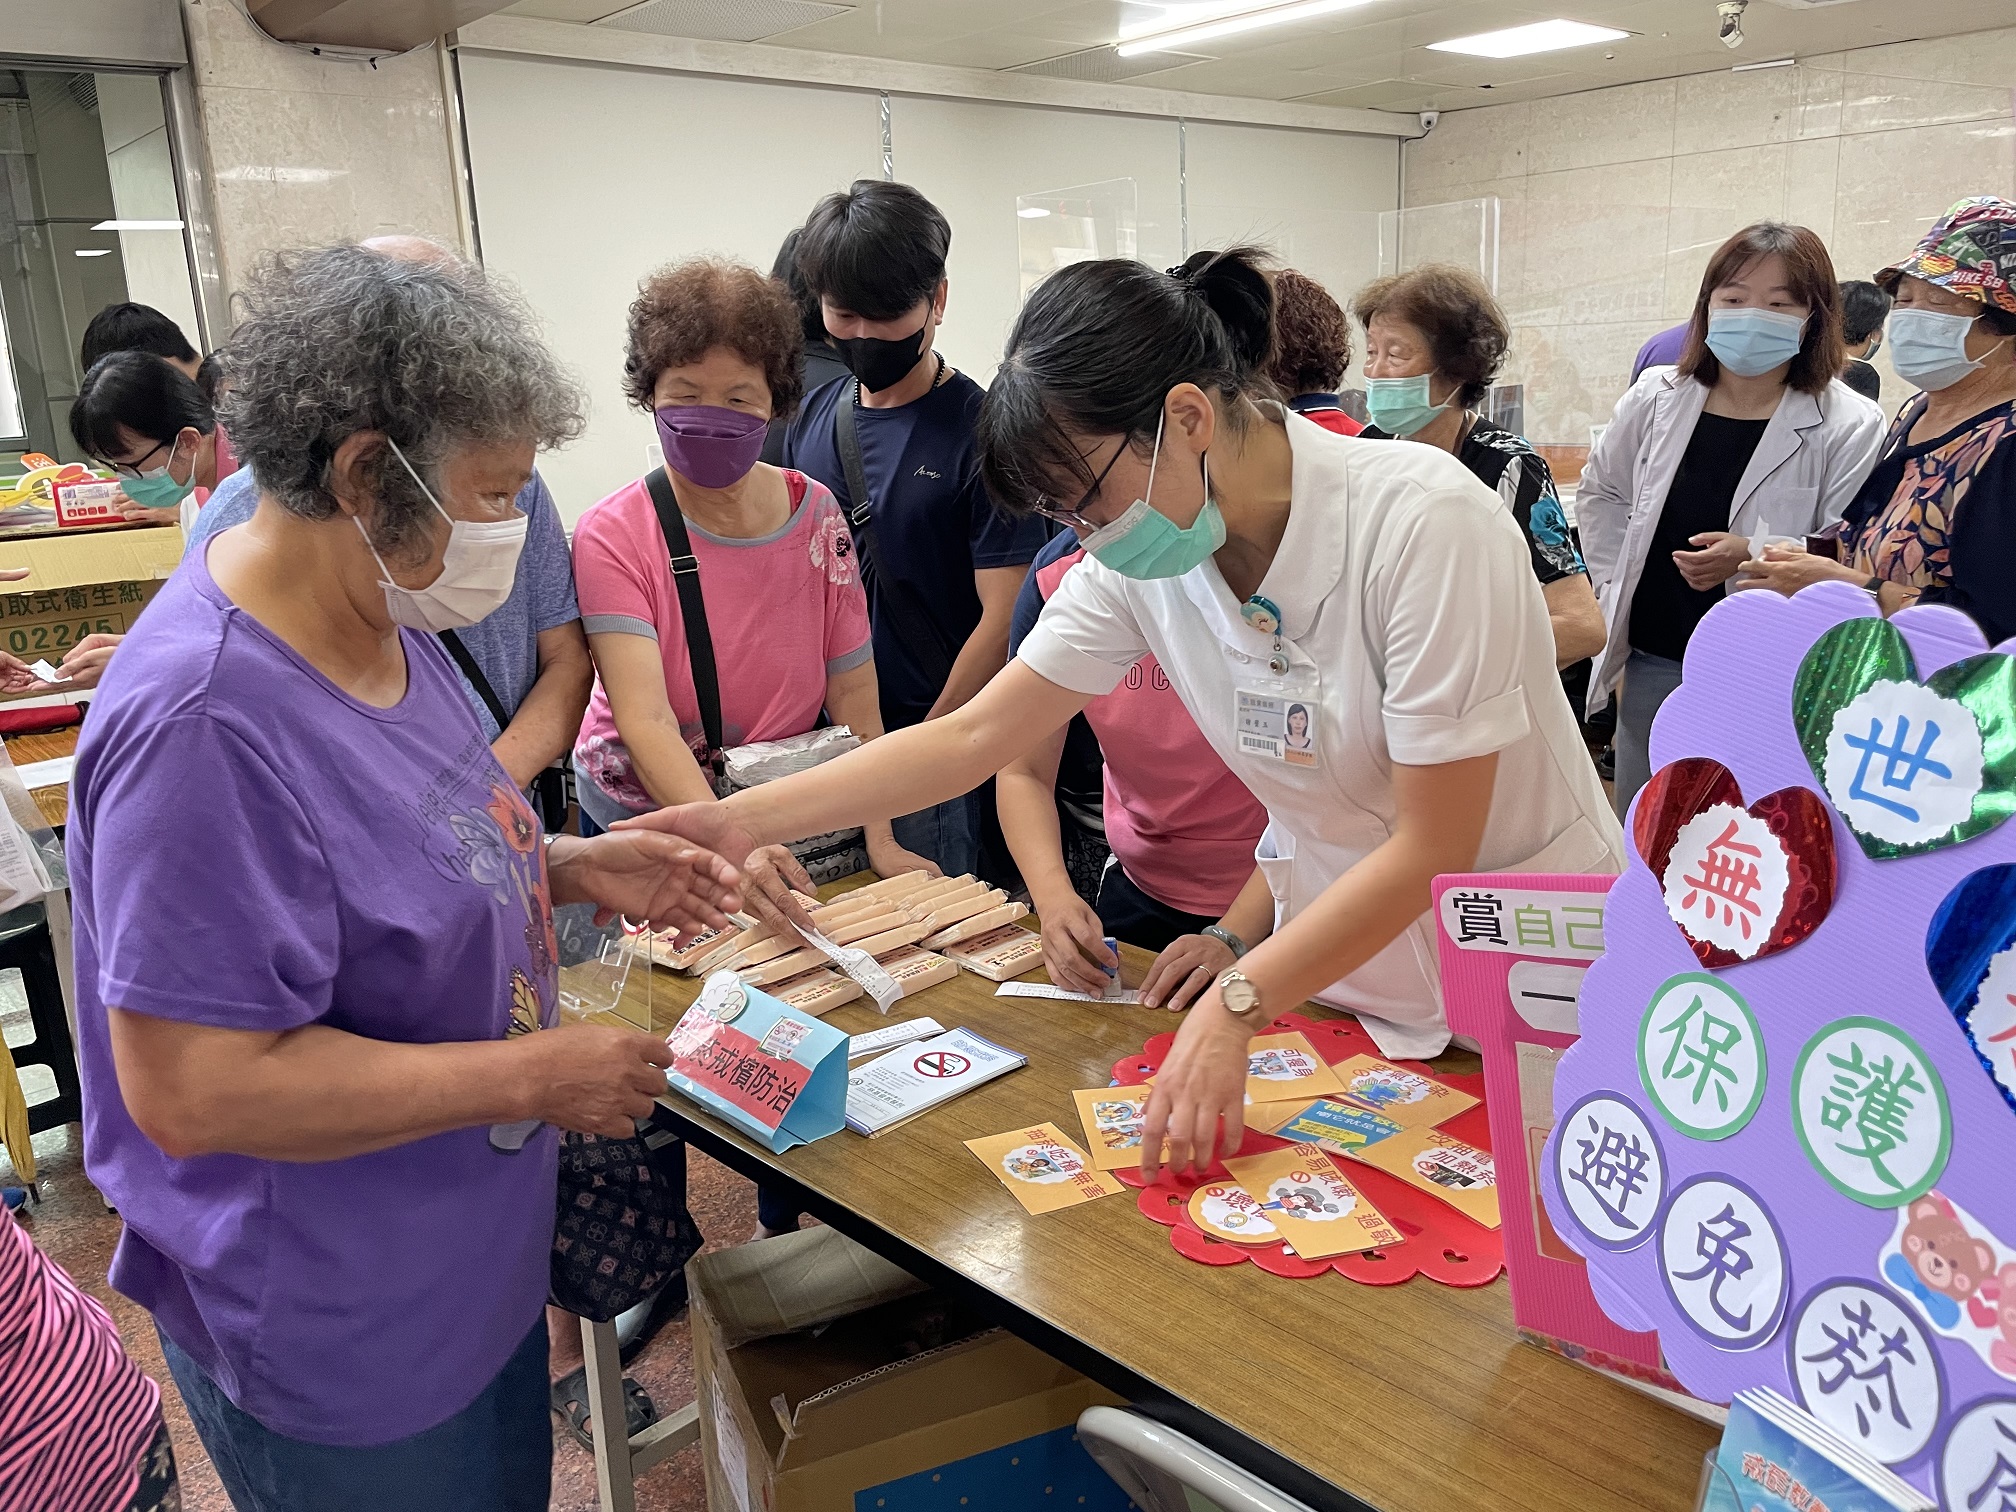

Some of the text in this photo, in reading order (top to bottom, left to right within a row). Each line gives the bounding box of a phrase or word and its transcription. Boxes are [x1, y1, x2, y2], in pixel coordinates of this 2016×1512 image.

[0, 583, 143, 618] 取式衛生紙
[9, 619, 114, 653] 02245
[1843, 714, 1953, 824] 世
[1453, 892, 1605, 950] 賞自己
[1681, 819, 1763, 940] 無
[1658, 994, 1743, 1113] 保
[1568, 1115, 1650, 1231] 避
[1821, 1041, 1927, 1191] 護
[1672, 1202, 1754, 1331] 免
[1802, 1299, 1916, 1438] 菸
